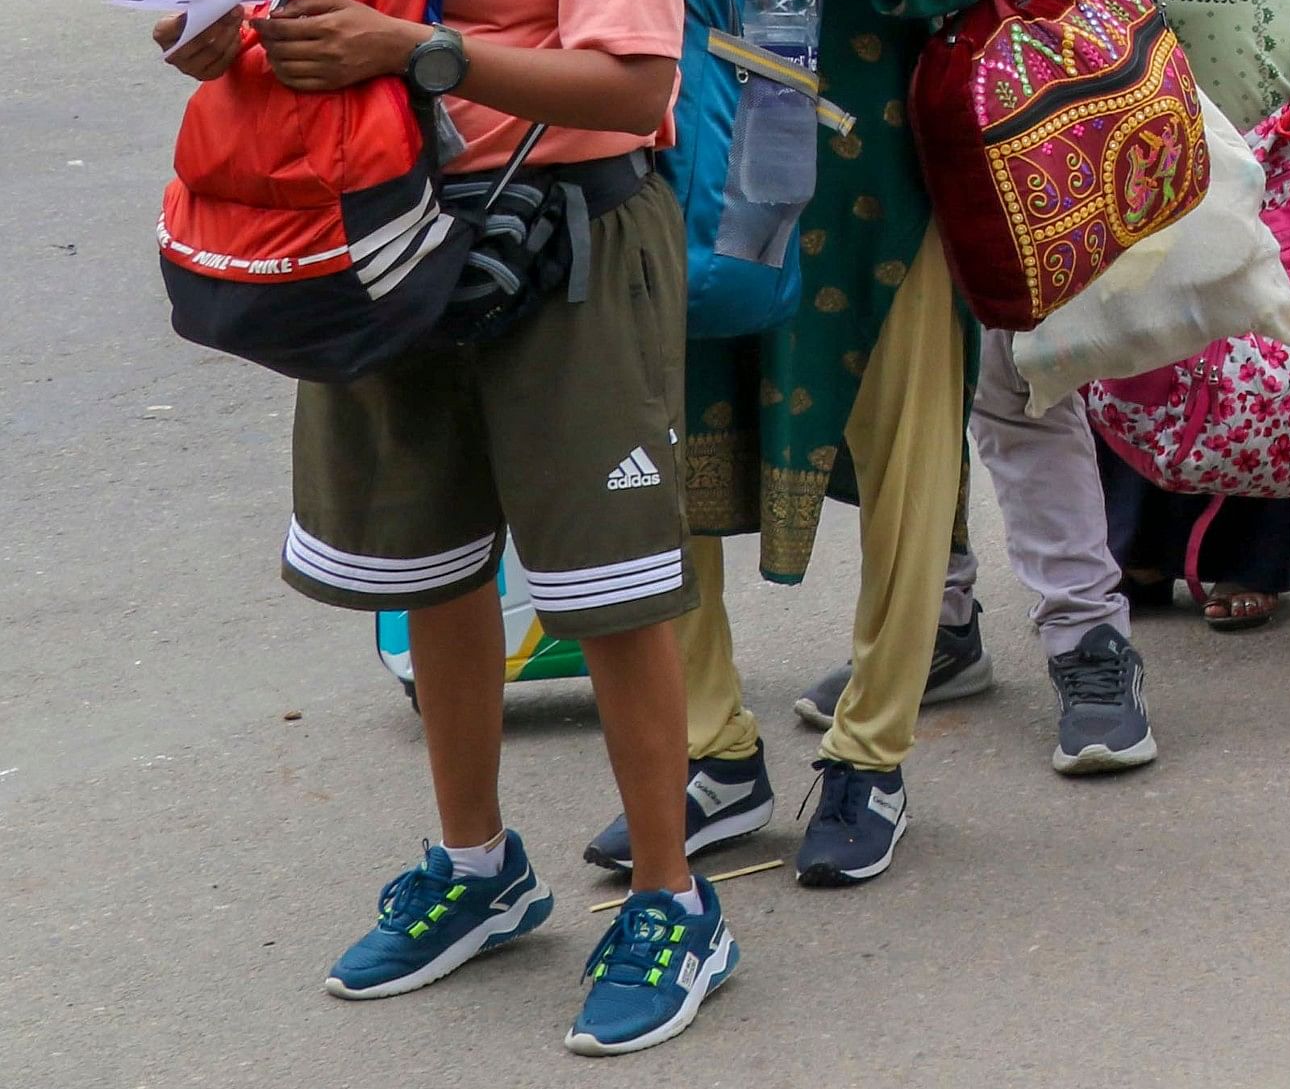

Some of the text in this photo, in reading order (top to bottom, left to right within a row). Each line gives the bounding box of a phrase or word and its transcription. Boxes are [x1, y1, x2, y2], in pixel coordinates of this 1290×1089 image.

[192, 250, 293, 275] NIKE NIKE
[607, 474, 661, 490] adidas
